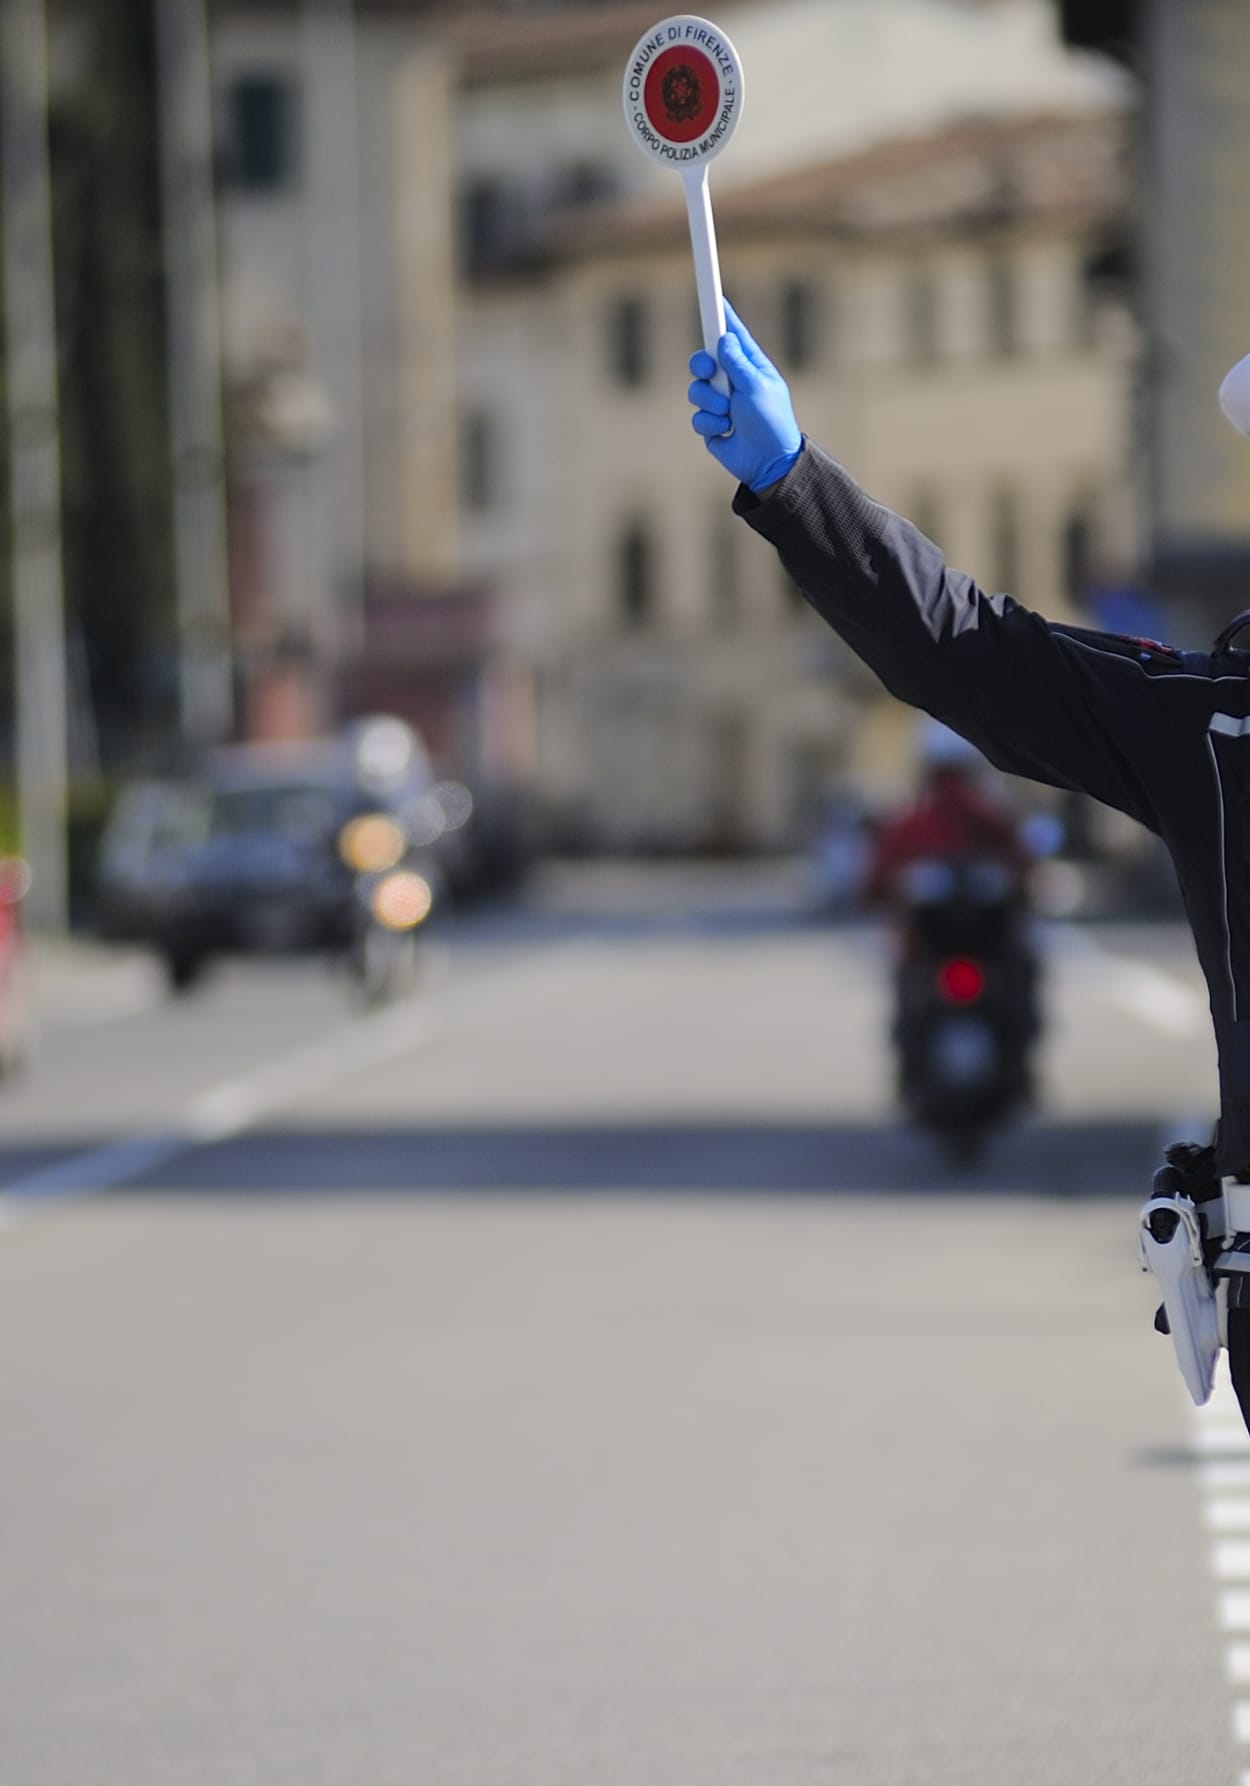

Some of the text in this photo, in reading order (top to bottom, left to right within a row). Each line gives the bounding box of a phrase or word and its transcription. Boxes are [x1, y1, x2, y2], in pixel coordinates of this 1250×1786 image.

[629, 25, 734, 102] COMUNE DI FIRENZE
[633, 88, 735, 160] CORPO POLIZIA MUNICIPALE
